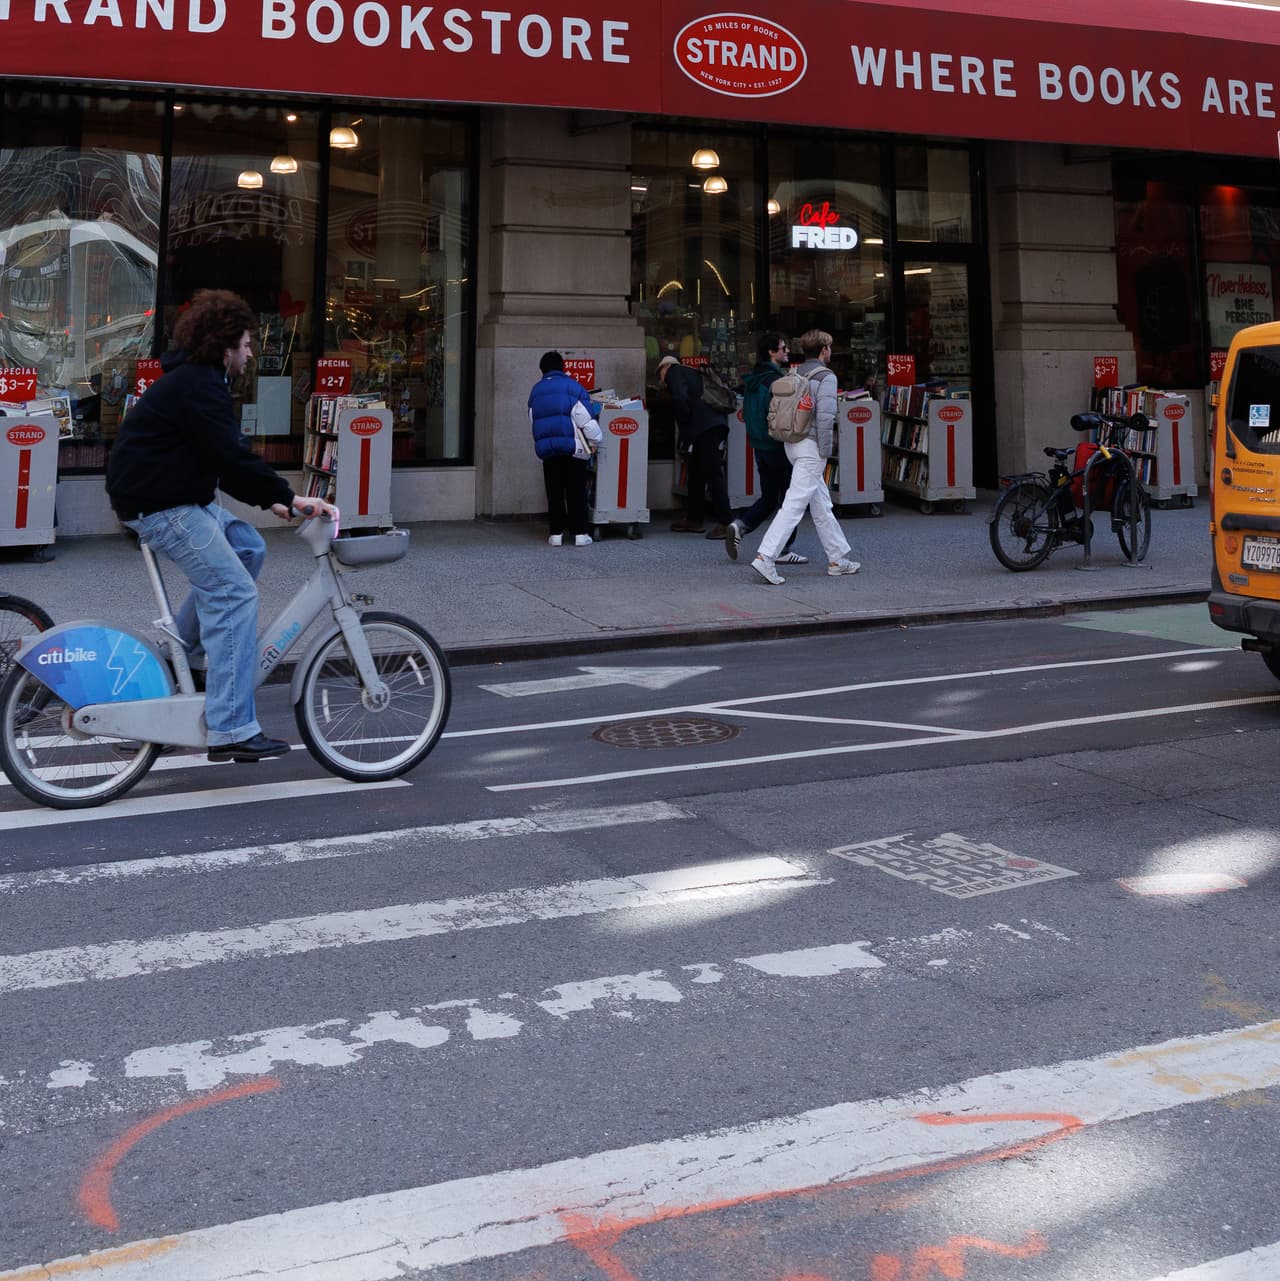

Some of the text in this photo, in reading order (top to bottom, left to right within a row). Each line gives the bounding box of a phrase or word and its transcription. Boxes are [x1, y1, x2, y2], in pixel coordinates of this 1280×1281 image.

[703, 24, 713, 32] 18
[715, 22, 739, 30] MILES
[753, 25, 779, 39] BOOKS
[686, 37, 797, 72] STRAND
[700, 70, 714, 81] NEW
[715, 77, 732, 86] YORK
[768, 77, 783, 87] 1927
[851, 45, 1017, 97] WHERE
[1038, 62, 1182, 110] BOOKS
[1202, 77, 1276, 118] ARE
[792, 201, 858, 250] Cafe FRED
[317, 359, 350, 368] SPECIAL
[564, 361, 594, 369] SPECIAL
[888, 362, 912, 375] $3-7
[1210, 360, 1225, 372] $3-
[1095, 366, 1116, 379] $3-7
[352, 421, 381, 430] STRAND
[610, 423, 637, 431] STRAND
[9, 431, 43, 440] STRAND
[277, 622, 302, 651] bike
[38, 648, 97, 665] citi bike
